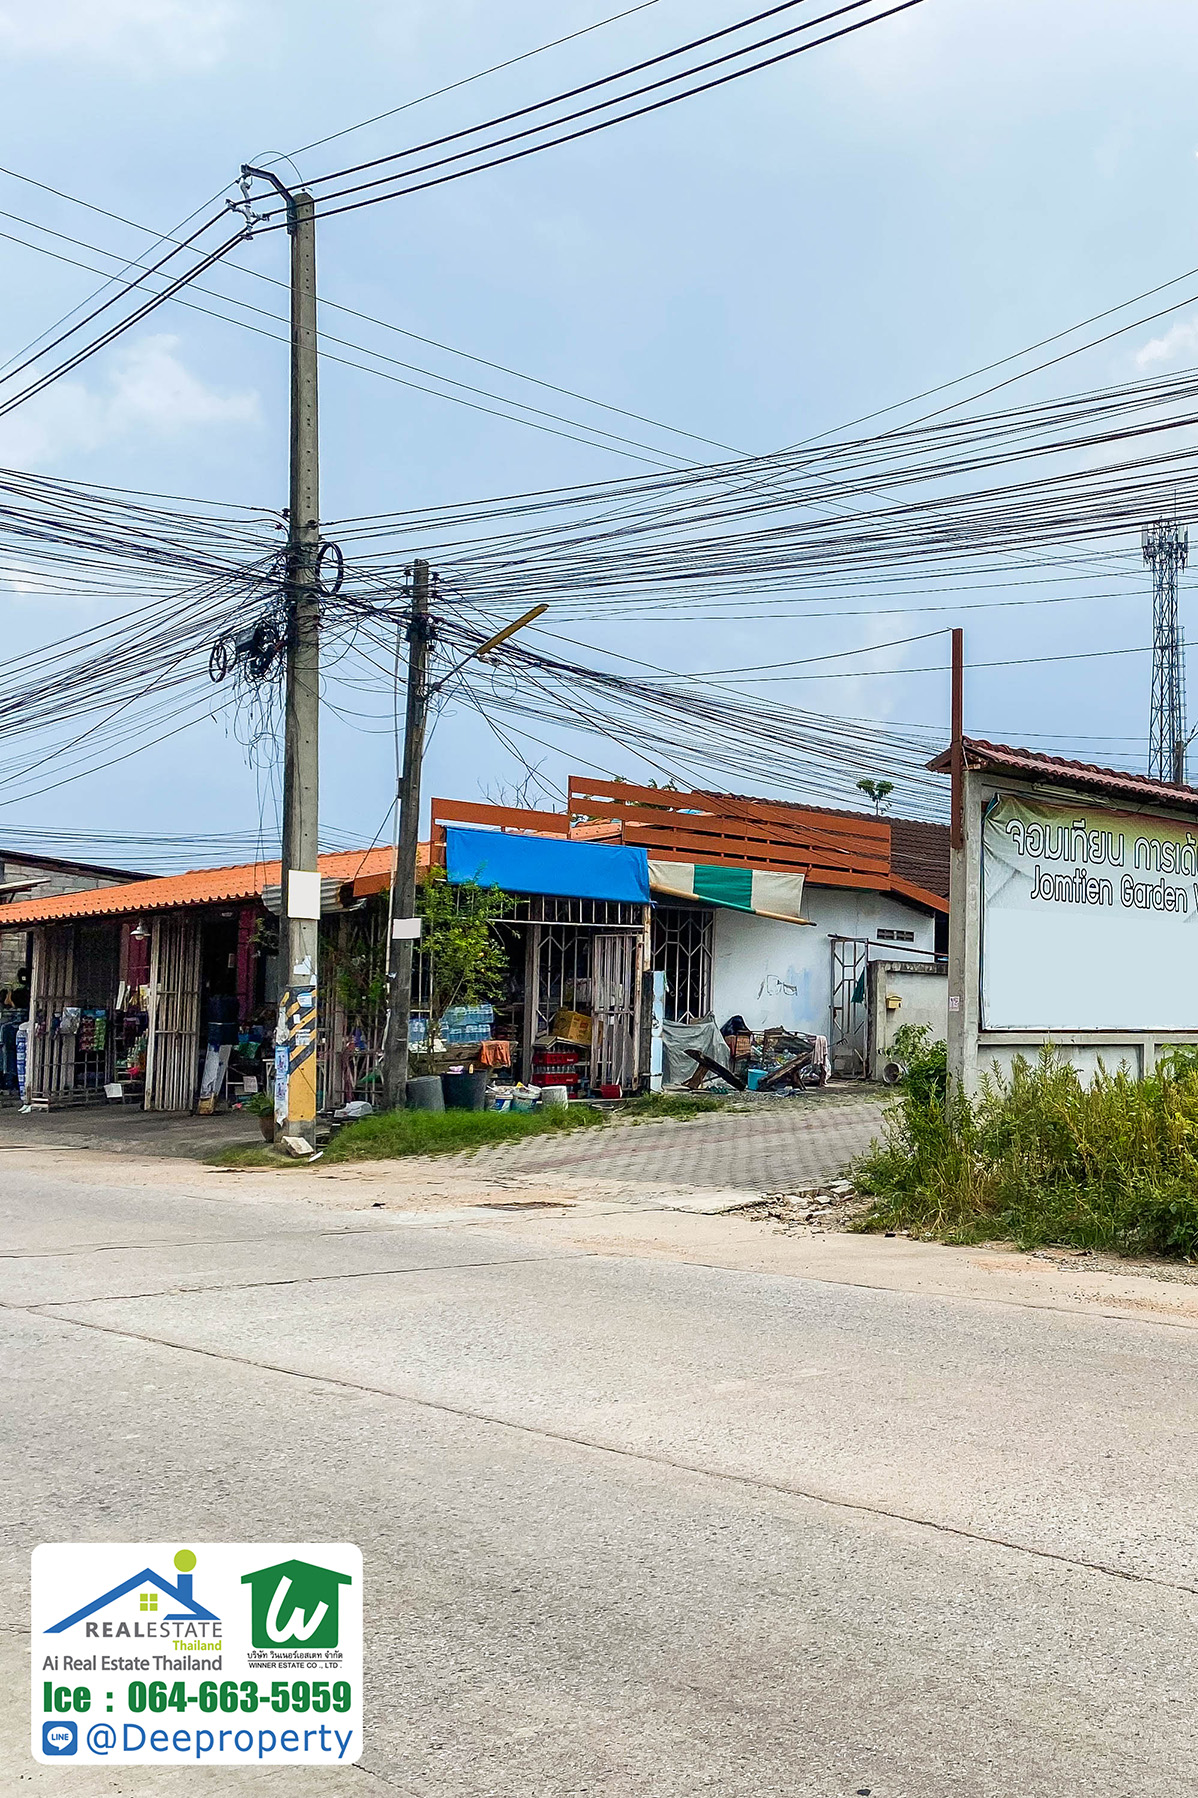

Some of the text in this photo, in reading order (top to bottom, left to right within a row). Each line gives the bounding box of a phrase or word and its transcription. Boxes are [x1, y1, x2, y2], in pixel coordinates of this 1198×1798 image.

[1005, 818, 1124, 867] จอมเทียน
[1030, 865, 1113, 905] Jomtien
[1120, 874, 1188, 913] Garden
